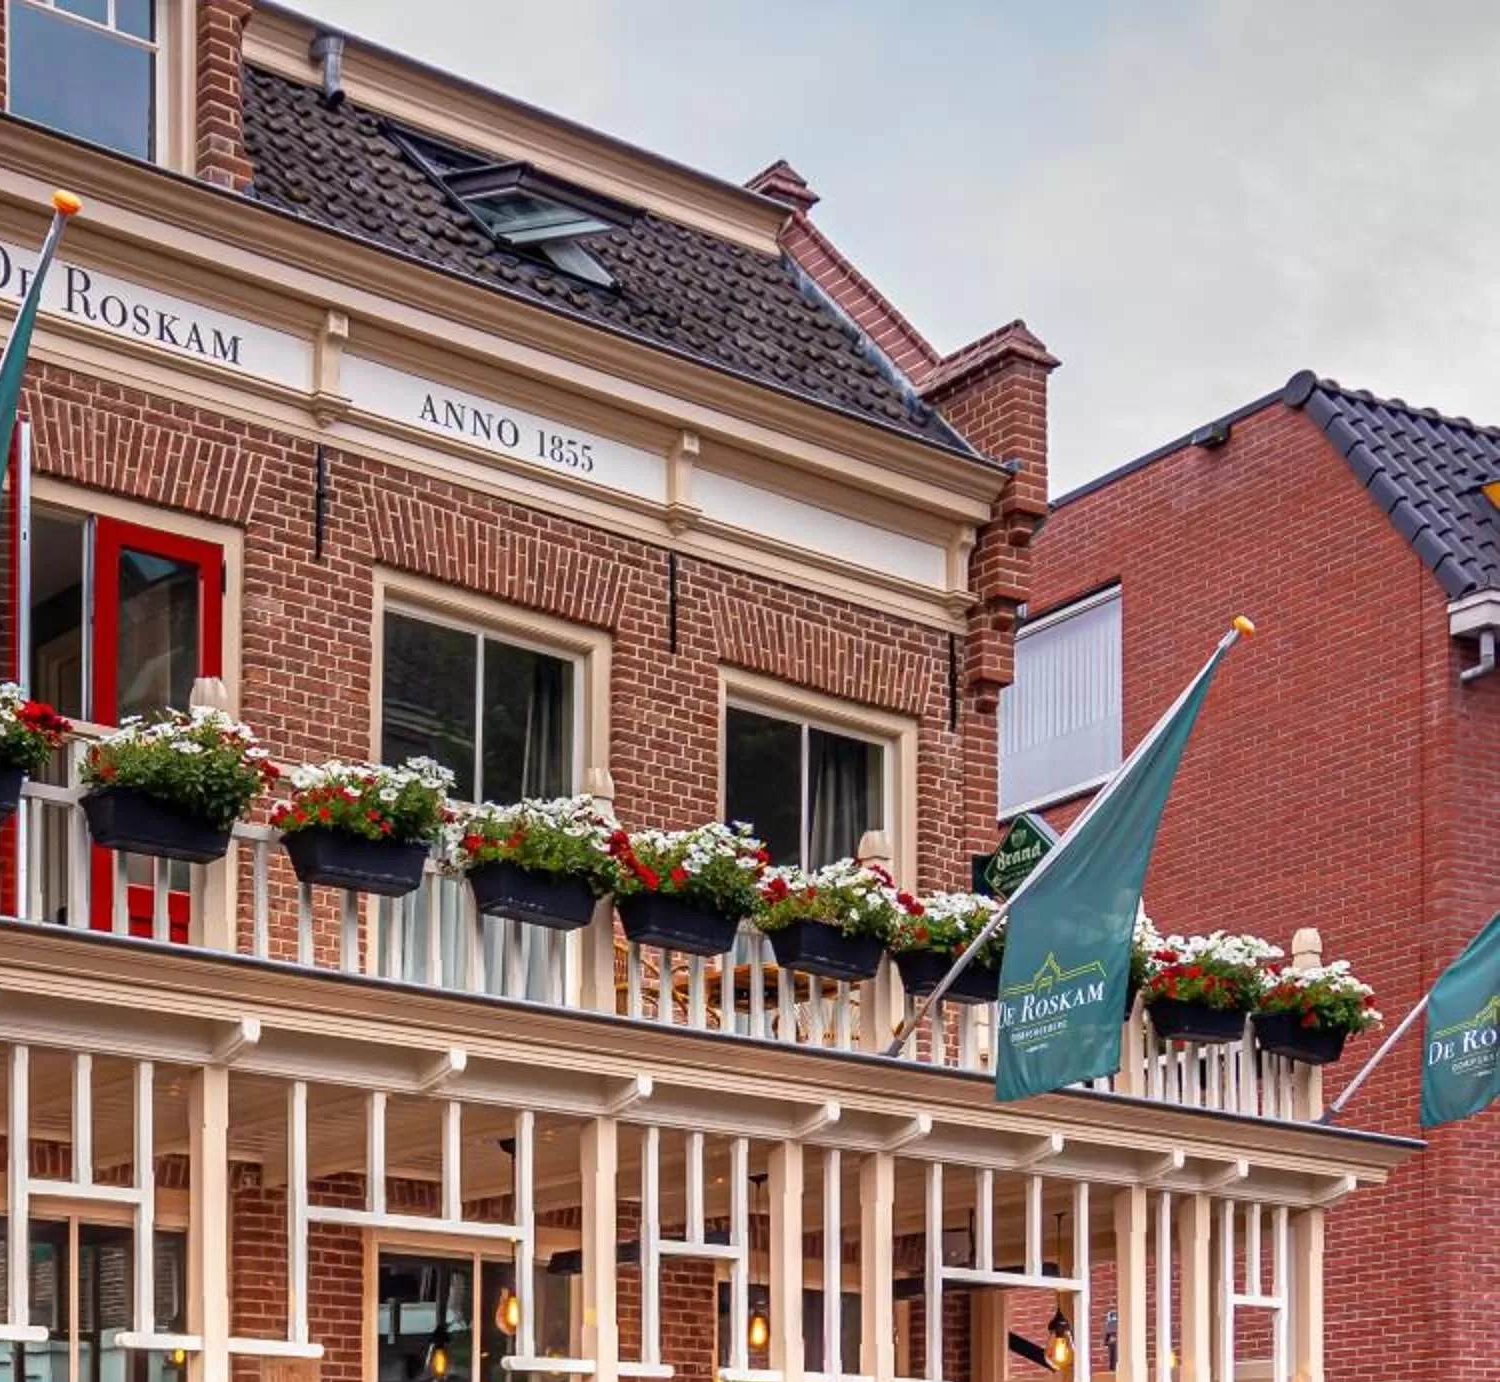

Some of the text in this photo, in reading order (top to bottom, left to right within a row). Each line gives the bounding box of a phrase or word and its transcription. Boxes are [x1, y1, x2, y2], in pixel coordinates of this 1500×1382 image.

[62, 265, 243, 365] ROSKAM
[419, 393, 594, 473] ANNO 1855
[997, 840, 1041, 871] Brand
[1021, 981, 1104, 1023] ROSKAM
[1428, 1041, 1455, 1067] DE
